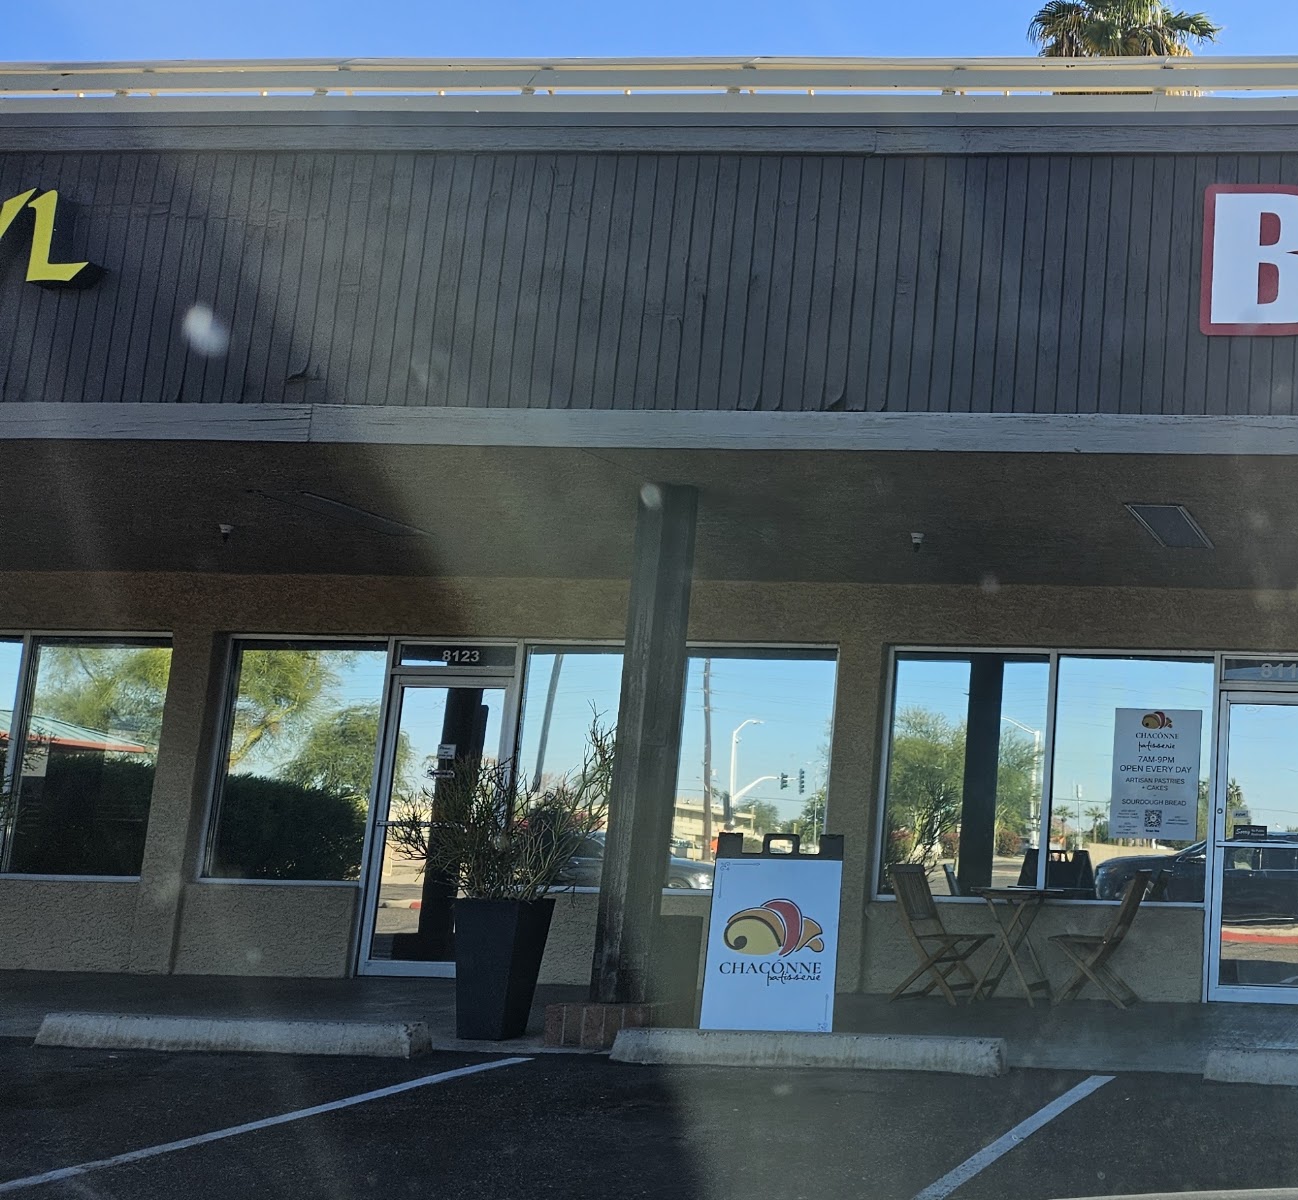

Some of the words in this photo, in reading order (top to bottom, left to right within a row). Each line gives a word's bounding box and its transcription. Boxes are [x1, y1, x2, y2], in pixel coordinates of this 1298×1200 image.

[441, 650, 480, 662] 8123
[1138, 755, 1175, 763] 7AM-9PM
[1119, 764, 1144, 772] OPEN
[1145, 765, 1174, 774] EVERY
[1175, 766, 1192, 774] DAY
[1146, 784, 1169, 792] CAKES
[1121, 798, 1164, 806] SOURDOUGH
[1164, 799, 1187, 807] BREAD
[766, 970, 821, 987] patisserie
